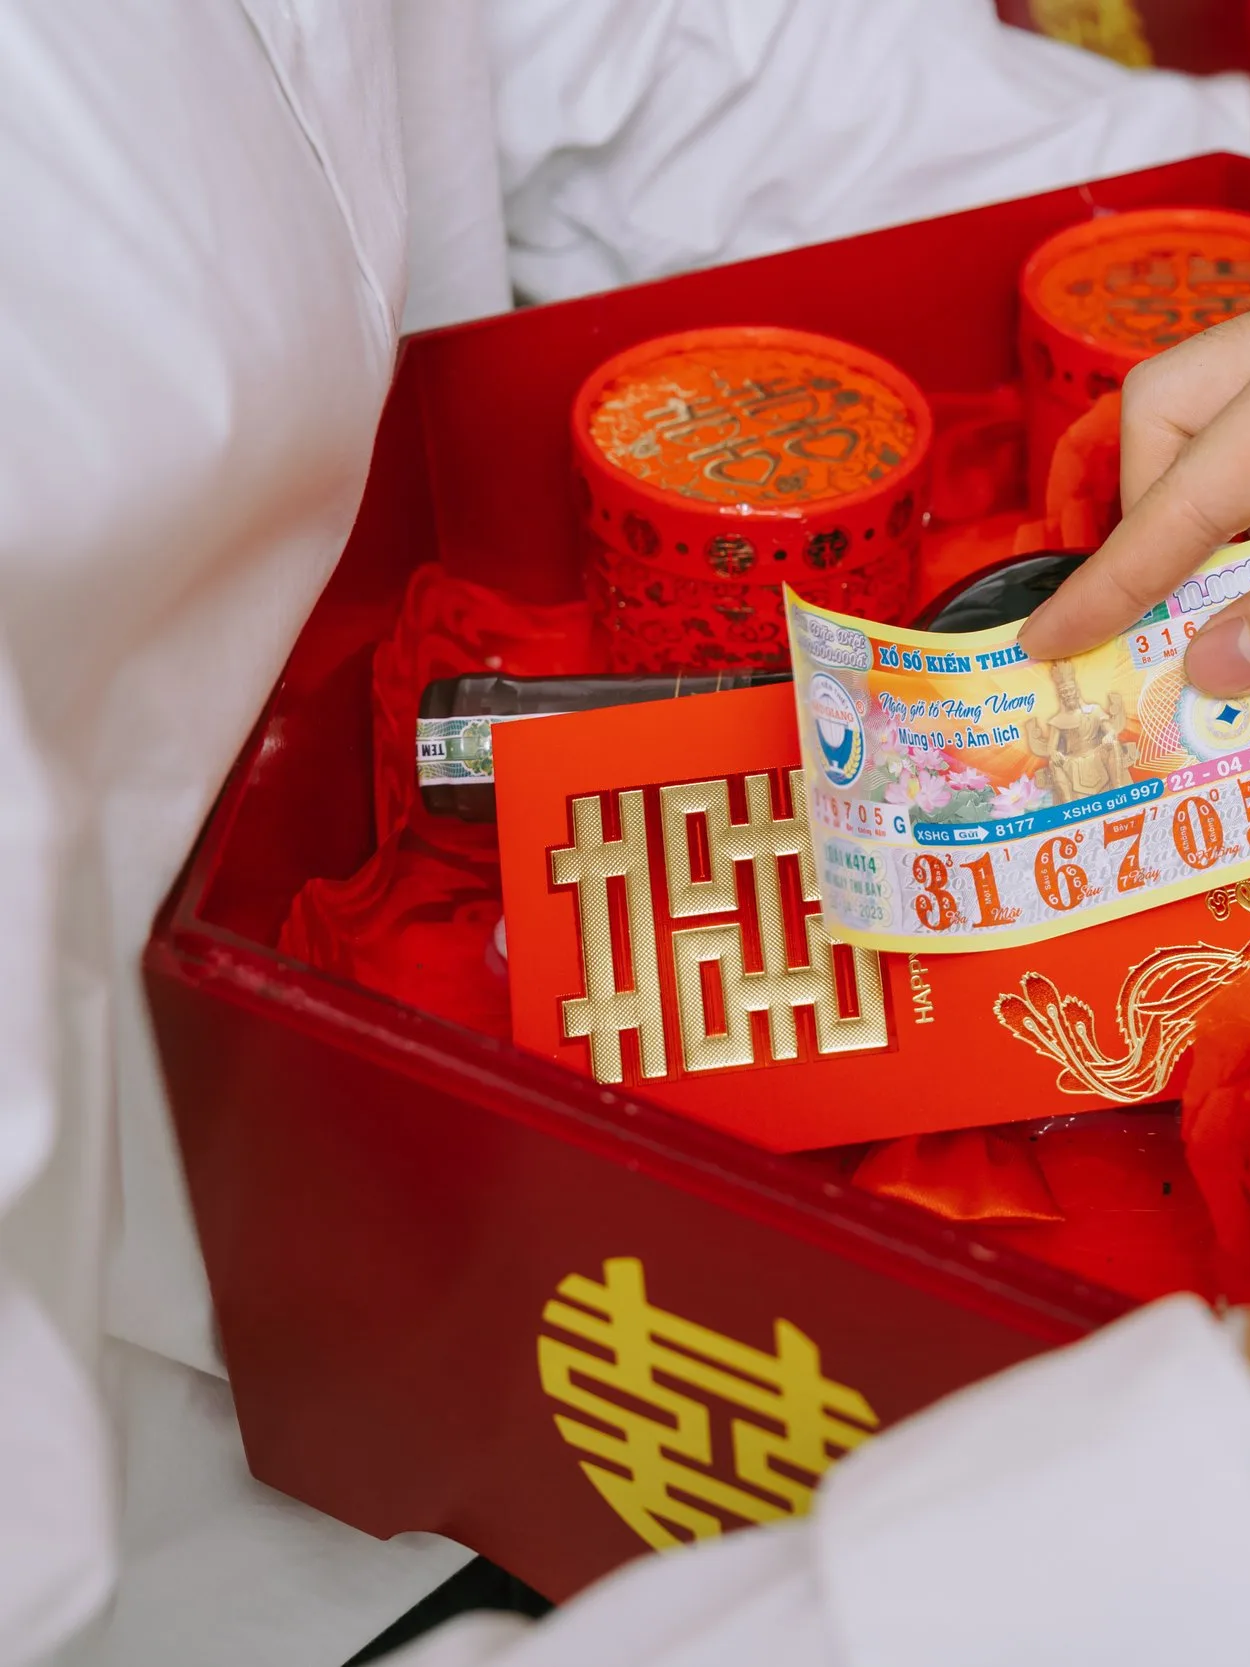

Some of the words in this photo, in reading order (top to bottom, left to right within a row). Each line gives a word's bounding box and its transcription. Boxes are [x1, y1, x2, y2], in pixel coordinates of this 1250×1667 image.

[902, 650, 922, 671] SỐ
[926, 653, 971, 673] KIẾN
[975, 643, 1028, 671] THIẾ
[942, 699, 982, 723] Hùng
[421, 743, 445, 757] TEM
[898, 728, 929, 750] Mùng
[931, 733, 944, 748] 10
[955, 732, 963, 748] 3
[967, 727, 990, 747] Âm
[993, 724, 1020, 746] lịch
[1170, 771, 1195, 791] 22
[1217, 757, 1242, 776] 04
[893, 815, 906, 834] G
[917, 830, 950, 841] XSHG
[995, 818, 1034, 837] 8177
[1063, 801, 1102, 820] XSHG
[1130, 782, 1159, 800] 997
[908, 953, 934, 1024] HAPP
